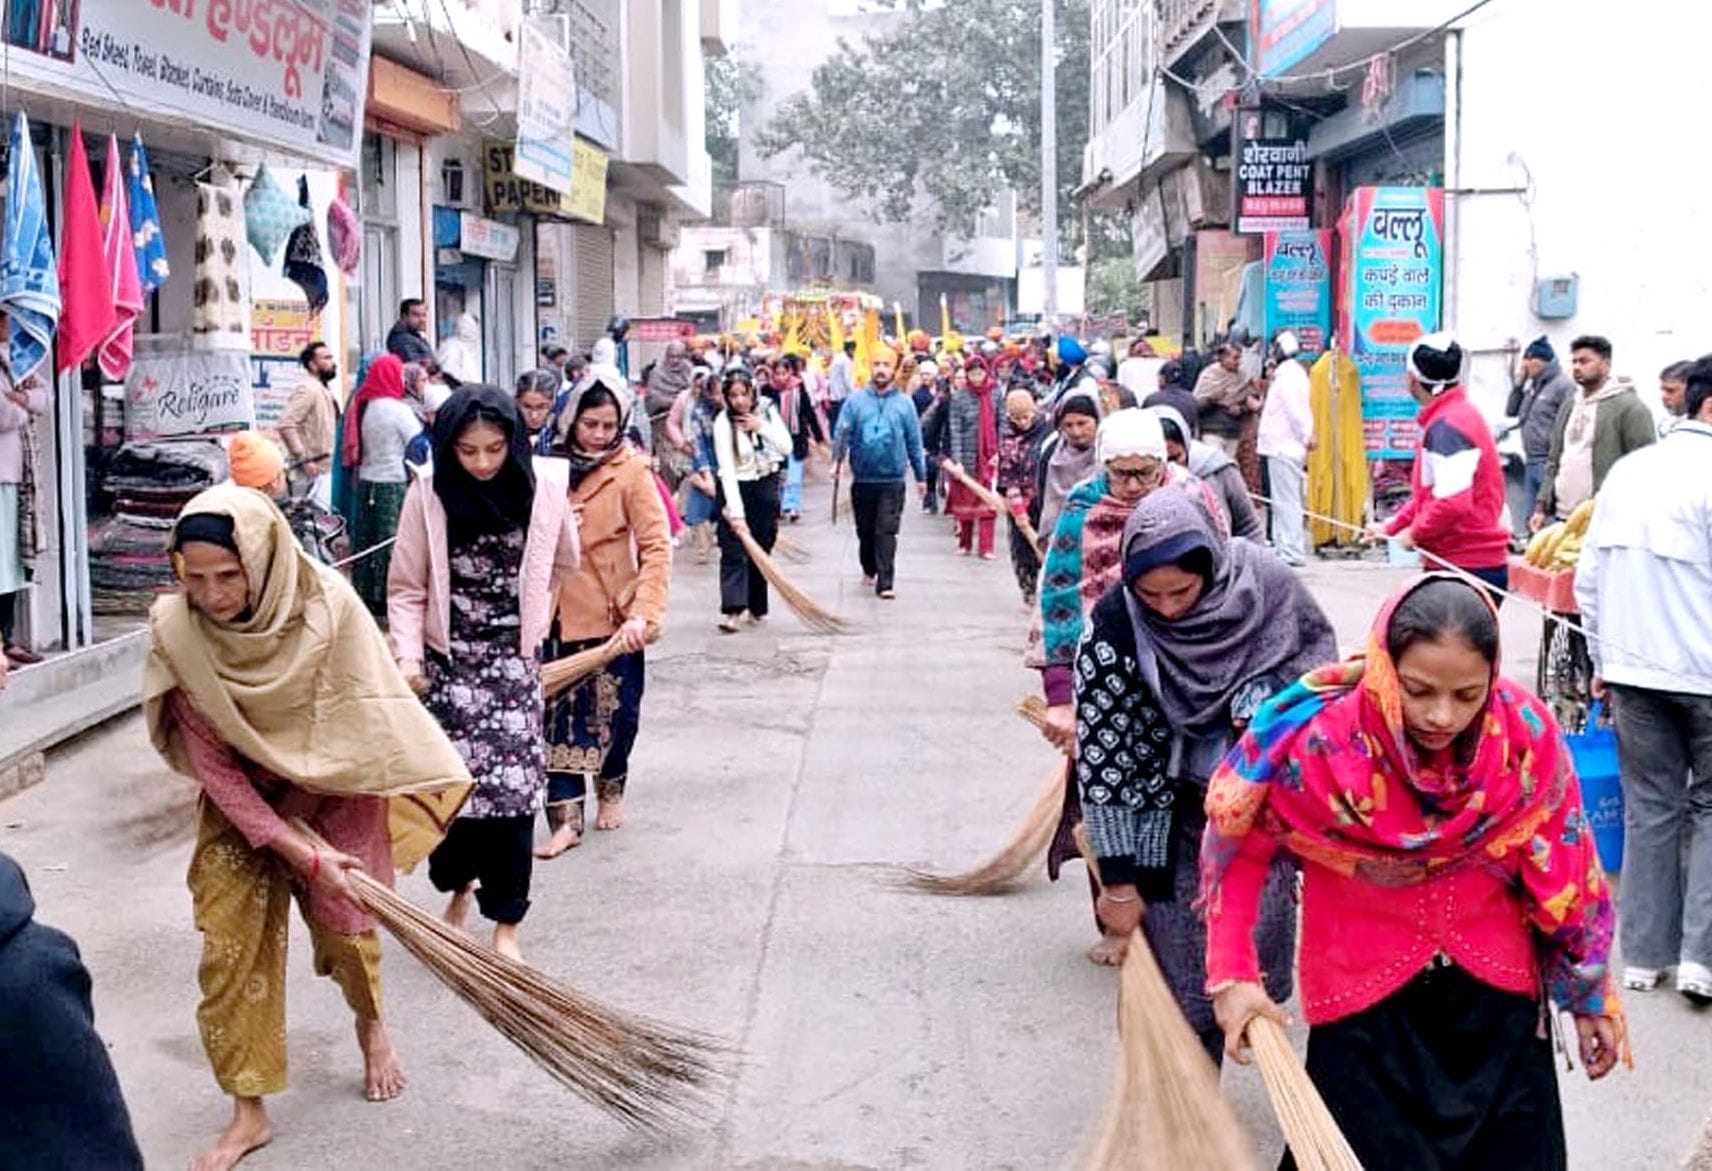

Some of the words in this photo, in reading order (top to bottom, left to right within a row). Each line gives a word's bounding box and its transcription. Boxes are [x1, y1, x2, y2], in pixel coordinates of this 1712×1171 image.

[1239, 164, 1273, 180] COAT
[1276, 164, 1310, 180] PENT
[1247, 180, 1302, 195] BLAZER
